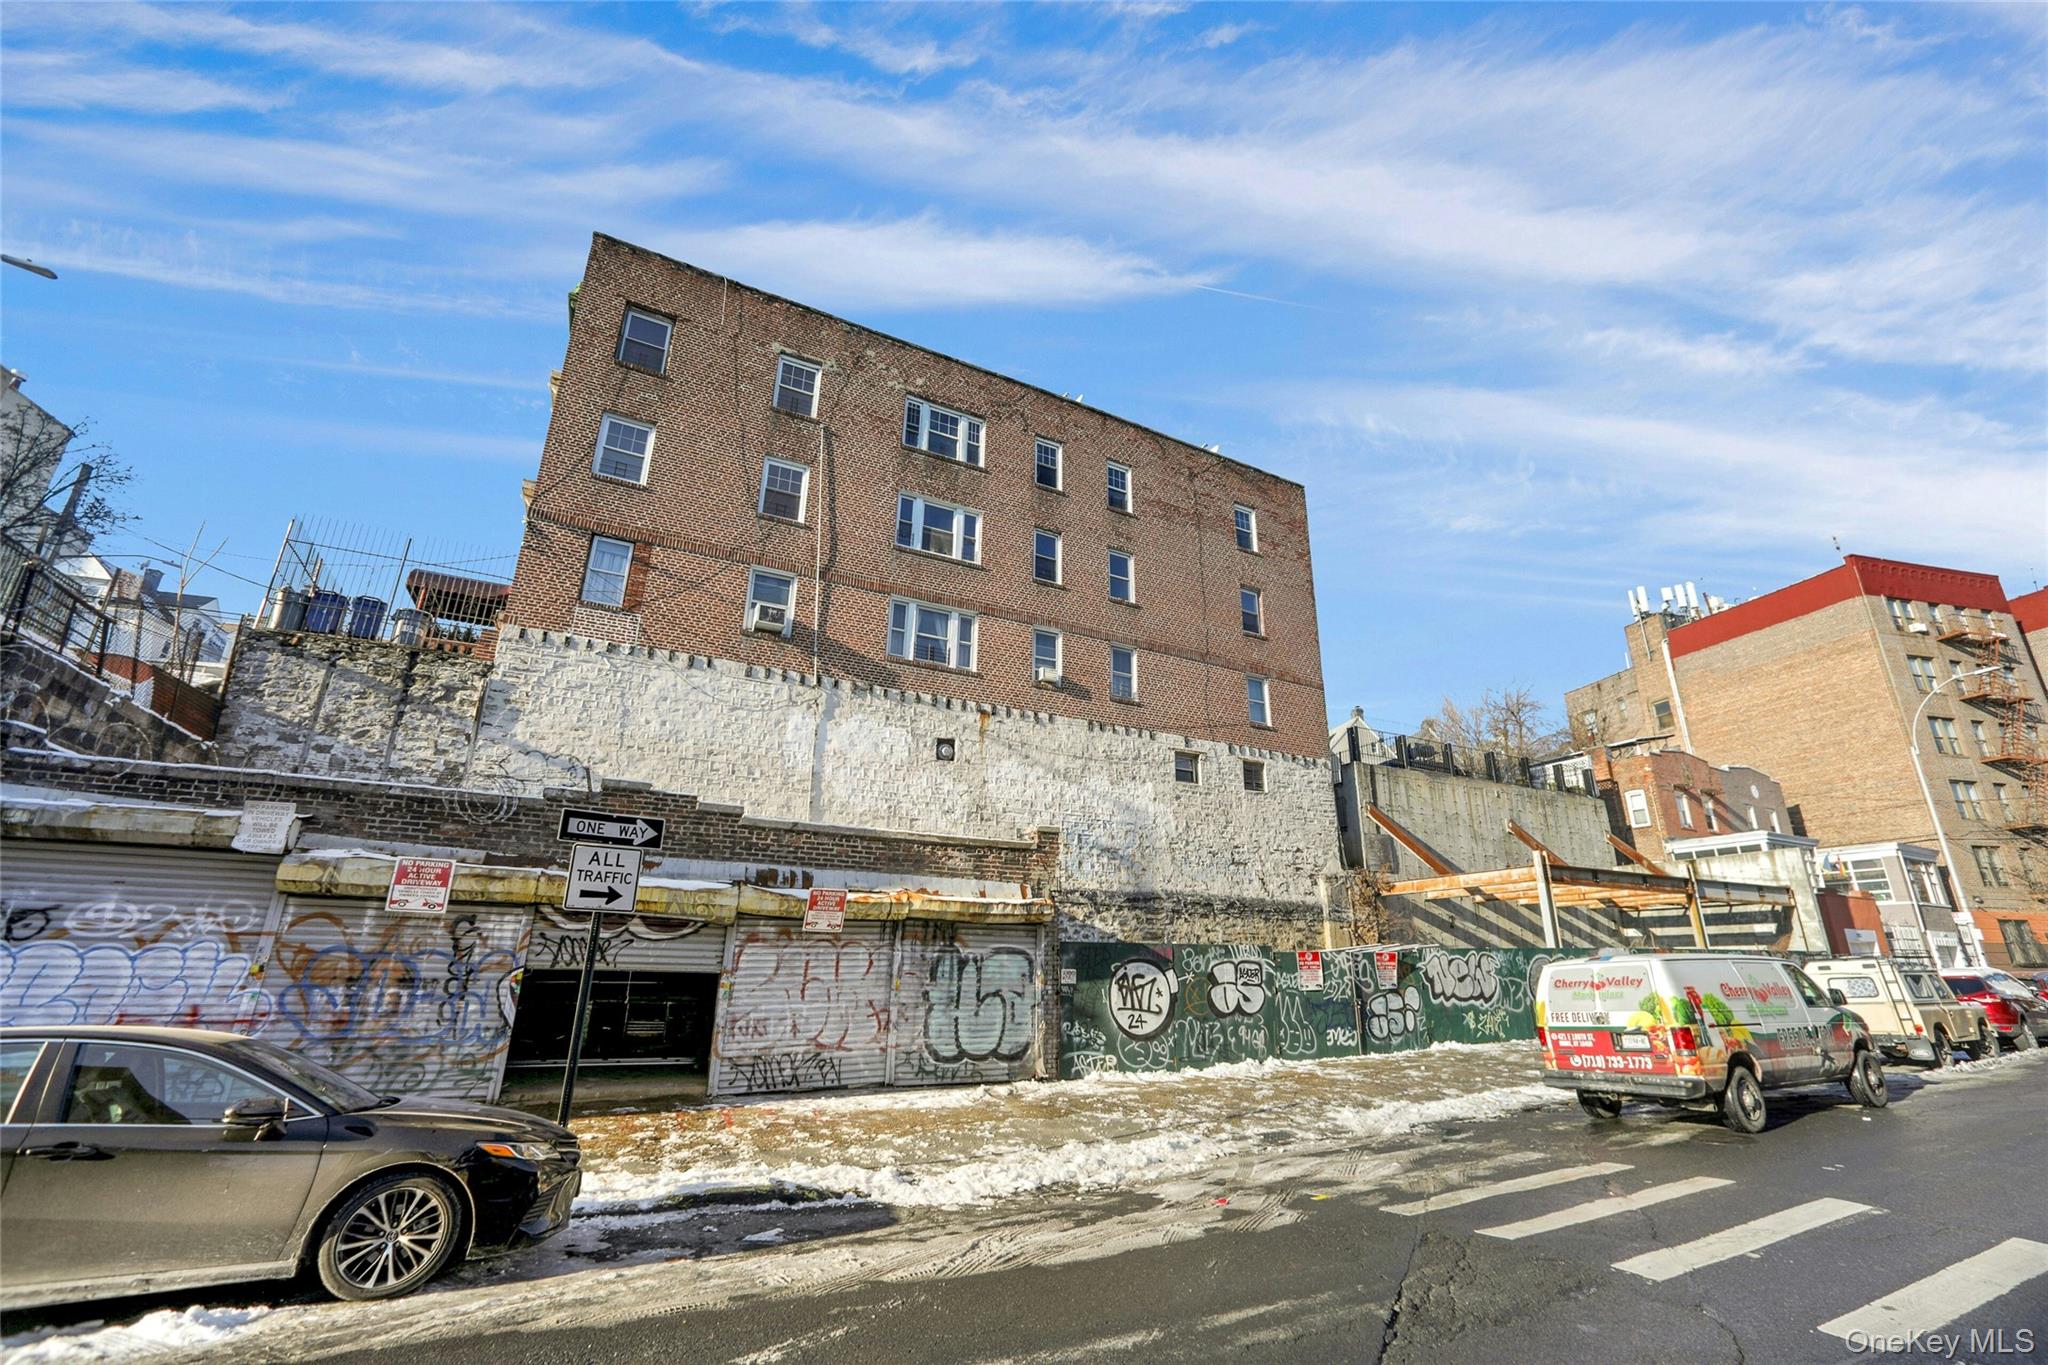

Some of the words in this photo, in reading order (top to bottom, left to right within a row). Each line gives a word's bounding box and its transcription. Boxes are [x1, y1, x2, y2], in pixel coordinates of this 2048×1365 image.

[576, 820, 606, 835] ONE
[619, 825, 648, 839] WAY
[414, 860, 450, 869] PARKING
[588, 851, 625, 868] ALL
[400, 878, 443, 887] DRIVEWAY
[407, 872, 436, 880] ACTIVE
[577, 869, 632, 885] TRAFFIC
[1553, 978, 1589, 990] Cherry
[1606, 975, 1644, 988] Valley
[1720, 982, 1754, 998] Cherry
[1763, 982, 1793, 997] Valley
[1127, 1013, 1148, 1030] 24
[1550, 1011, 1569, 1023] FREE
